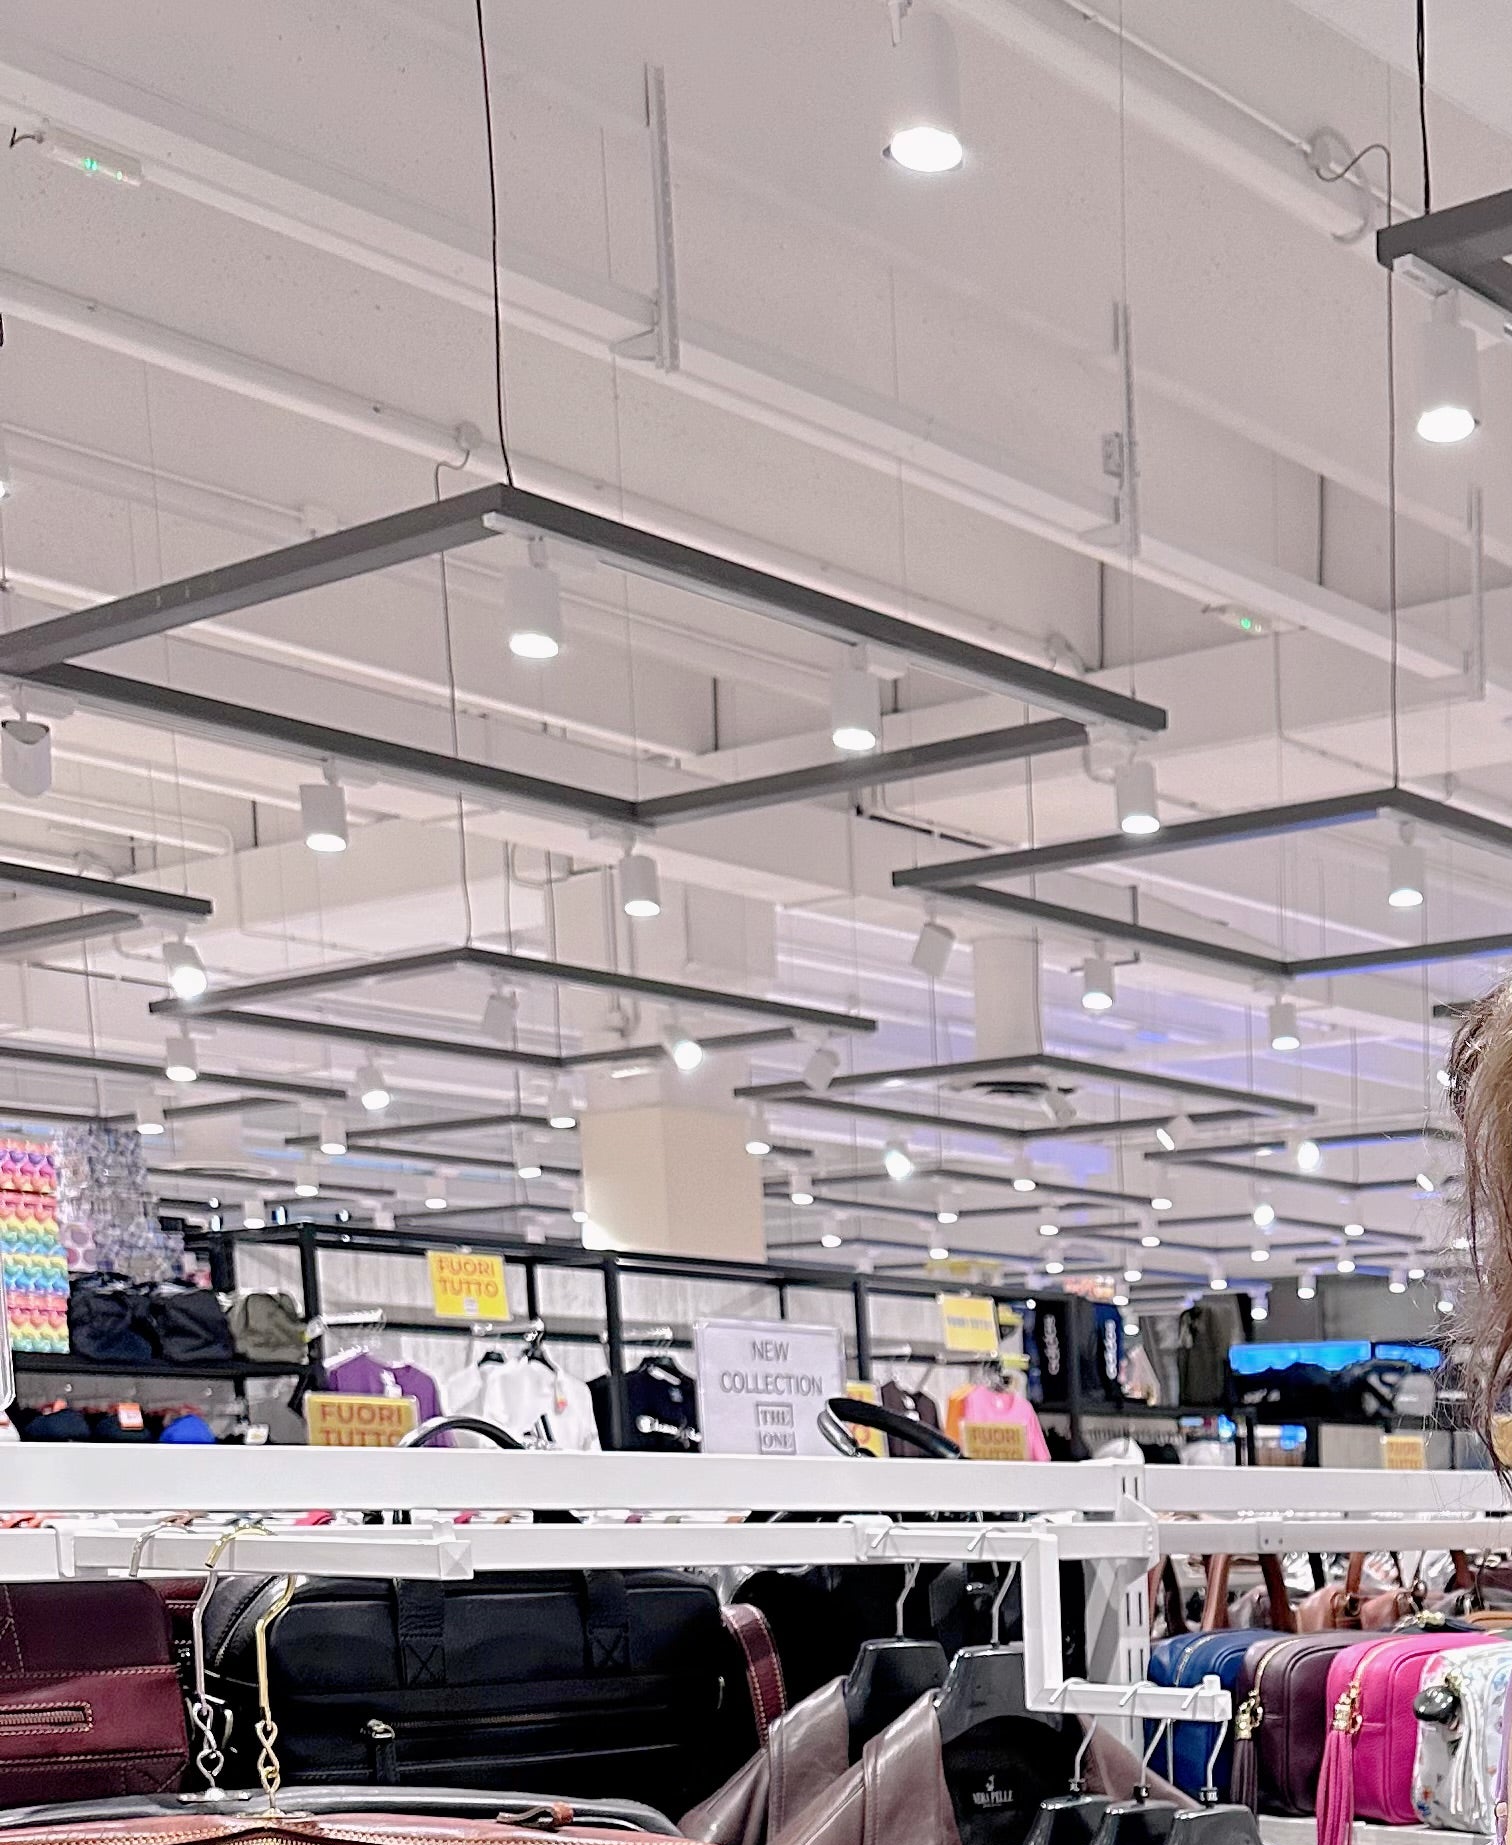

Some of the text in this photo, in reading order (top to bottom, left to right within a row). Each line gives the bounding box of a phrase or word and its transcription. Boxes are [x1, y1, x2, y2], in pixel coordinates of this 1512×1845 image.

[438, 1255, 496, 1278] FUORI
[439, 1276, 499, 1298] TUTTO
[752, 1340, 790, 1361] NEW
[720, 1370, 823, 1397] COLLECTION
[320, 1402, 402, 1426] FUORI
